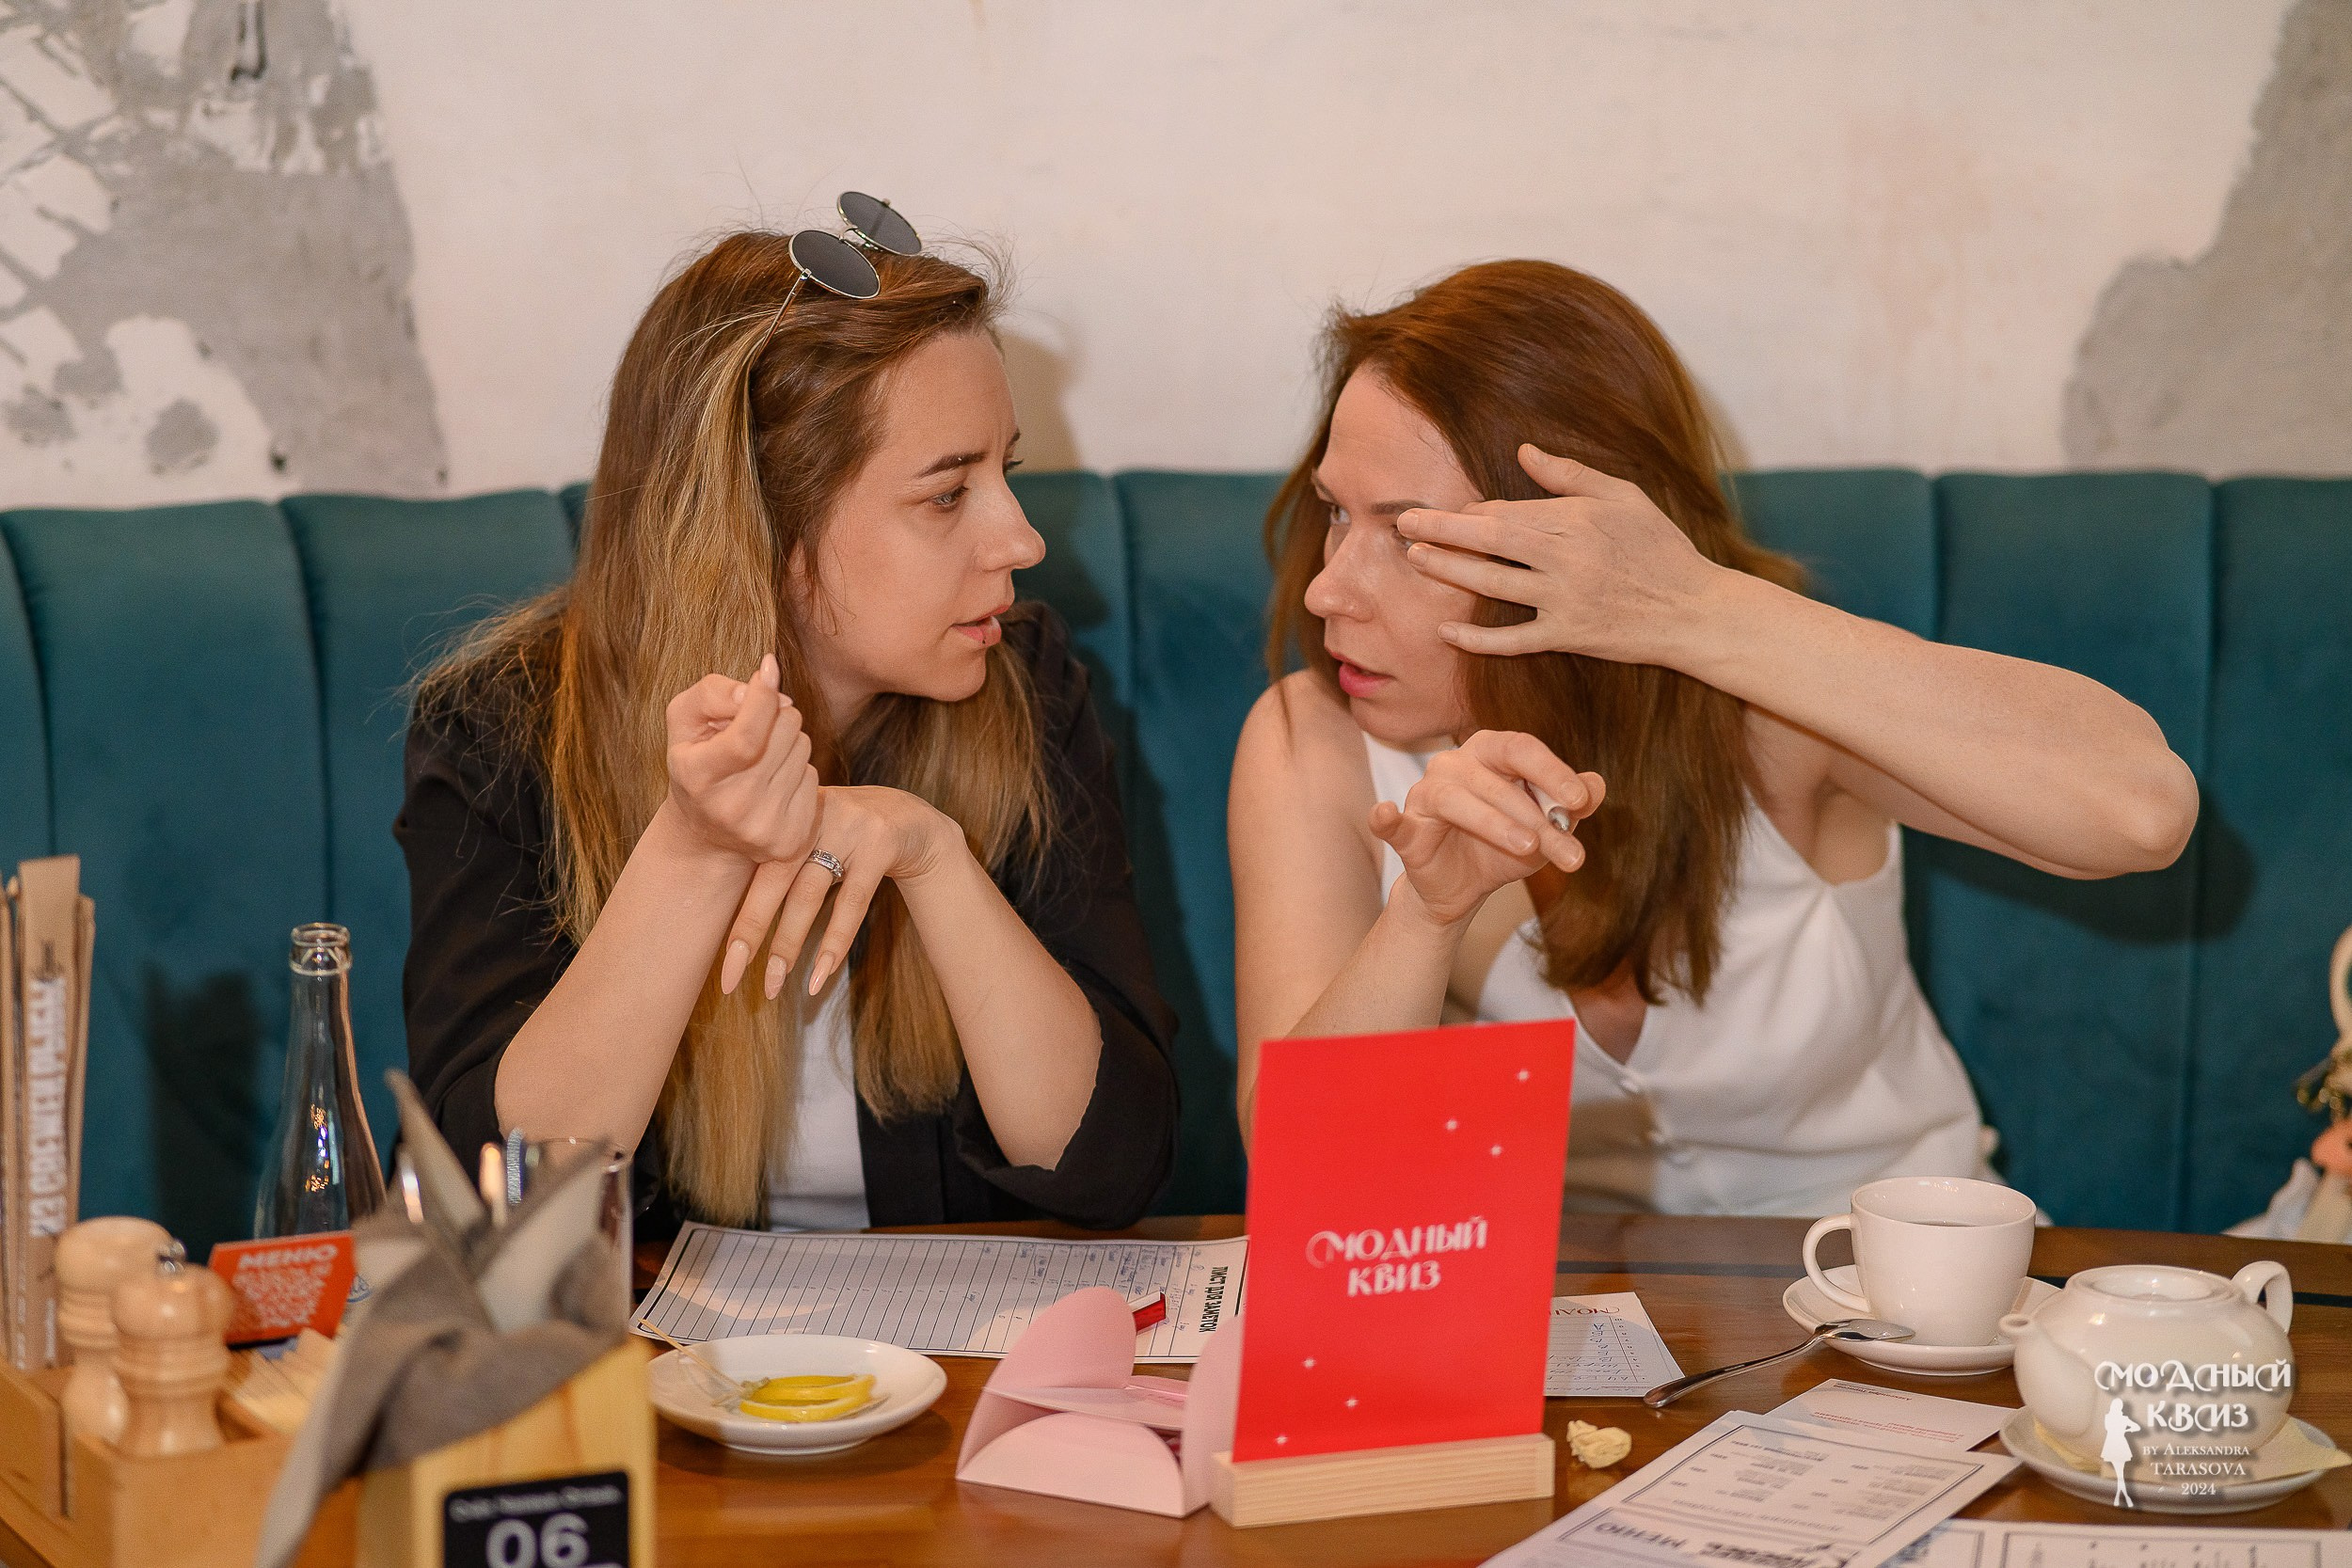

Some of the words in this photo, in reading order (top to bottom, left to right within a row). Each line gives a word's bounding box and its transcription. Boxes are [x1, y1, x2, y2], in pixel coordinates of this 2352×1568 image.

[1305, 1215, 1488, 1269] МОДНЫЙ
[1204, 1285, 1225, 1301] ДЛЯ
[1209, 1266, 1229, 1285] ЛИСТ
[1347, 1260, 1441, 1297] КВИЗ
[1199, 1300, 1222, 1333] ЗАМЕТОК
[485, 1513, 590, 1568] 06
